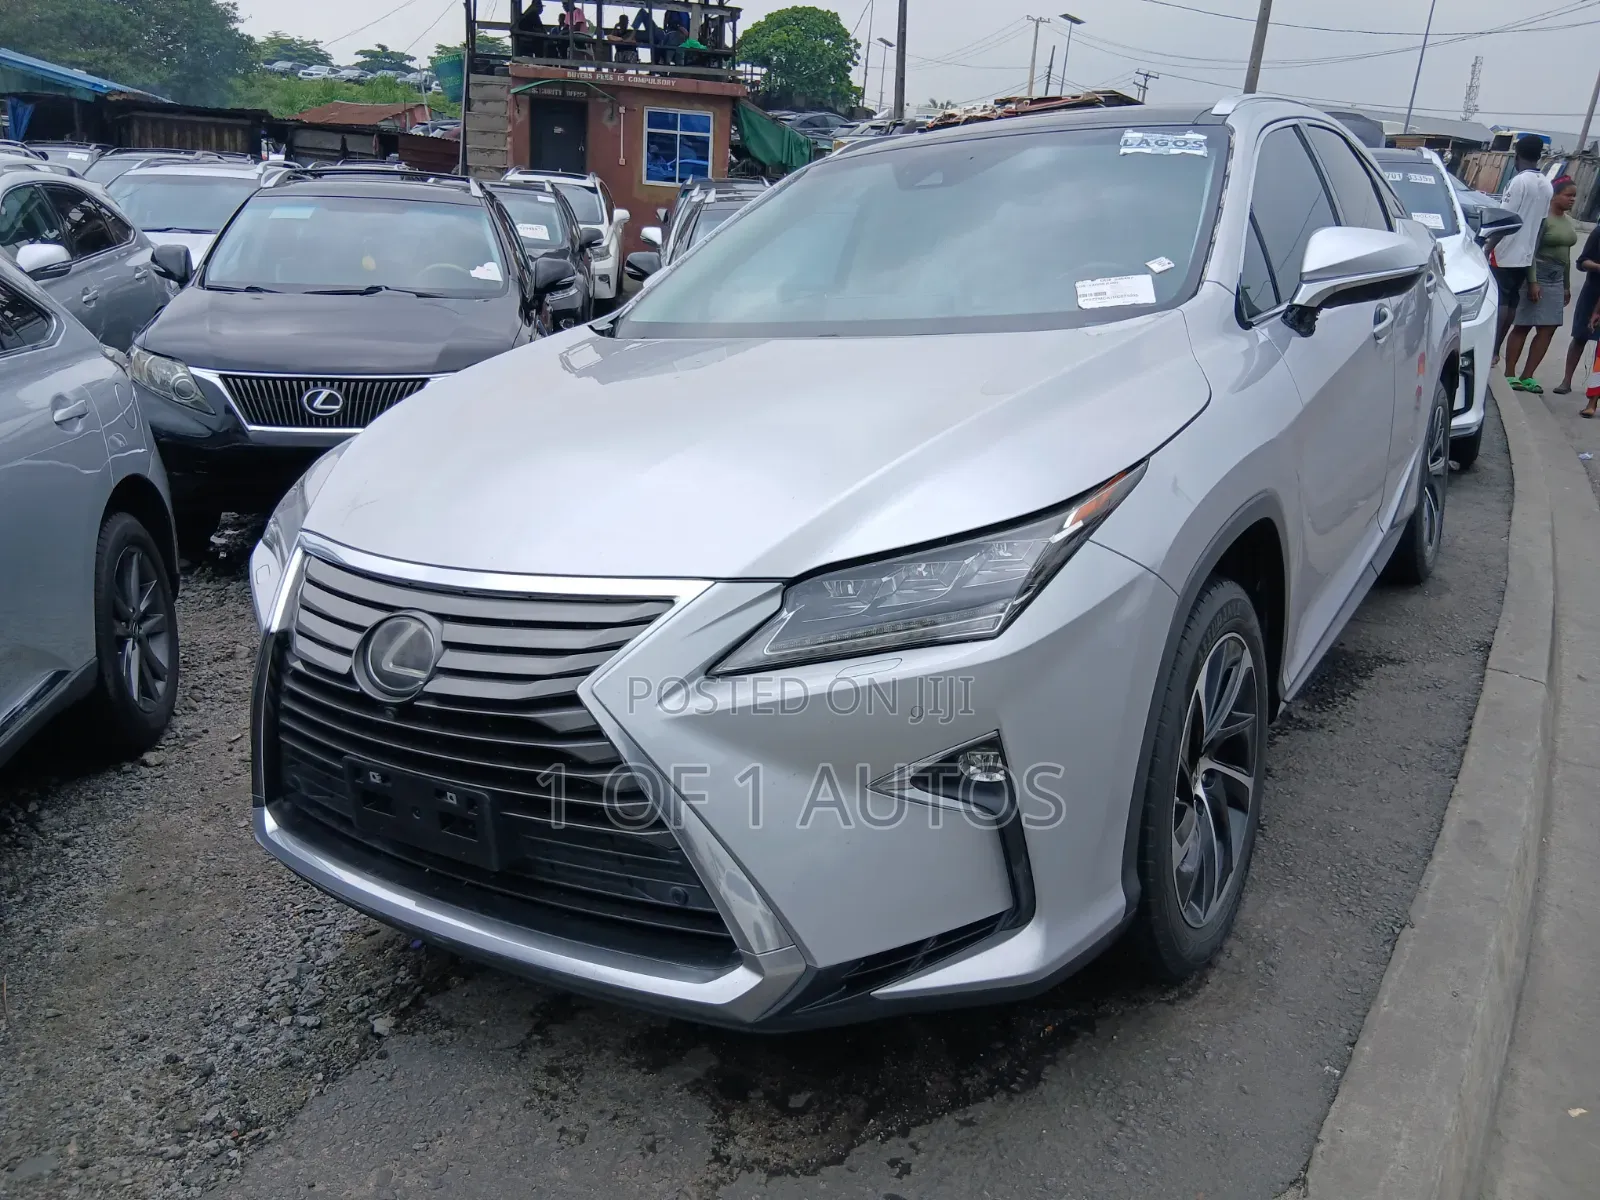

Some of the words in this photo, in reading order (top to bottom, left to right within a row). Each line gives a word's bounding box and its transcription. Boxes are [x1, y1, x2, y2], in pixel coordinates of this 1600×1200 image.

[567, 71, 593, 79] BUYERS
[617, 74, 625, 82] IS
[628, 76, 676, 87] COMPULSORY
[1122, 138, 1204, 148] LAGOS
